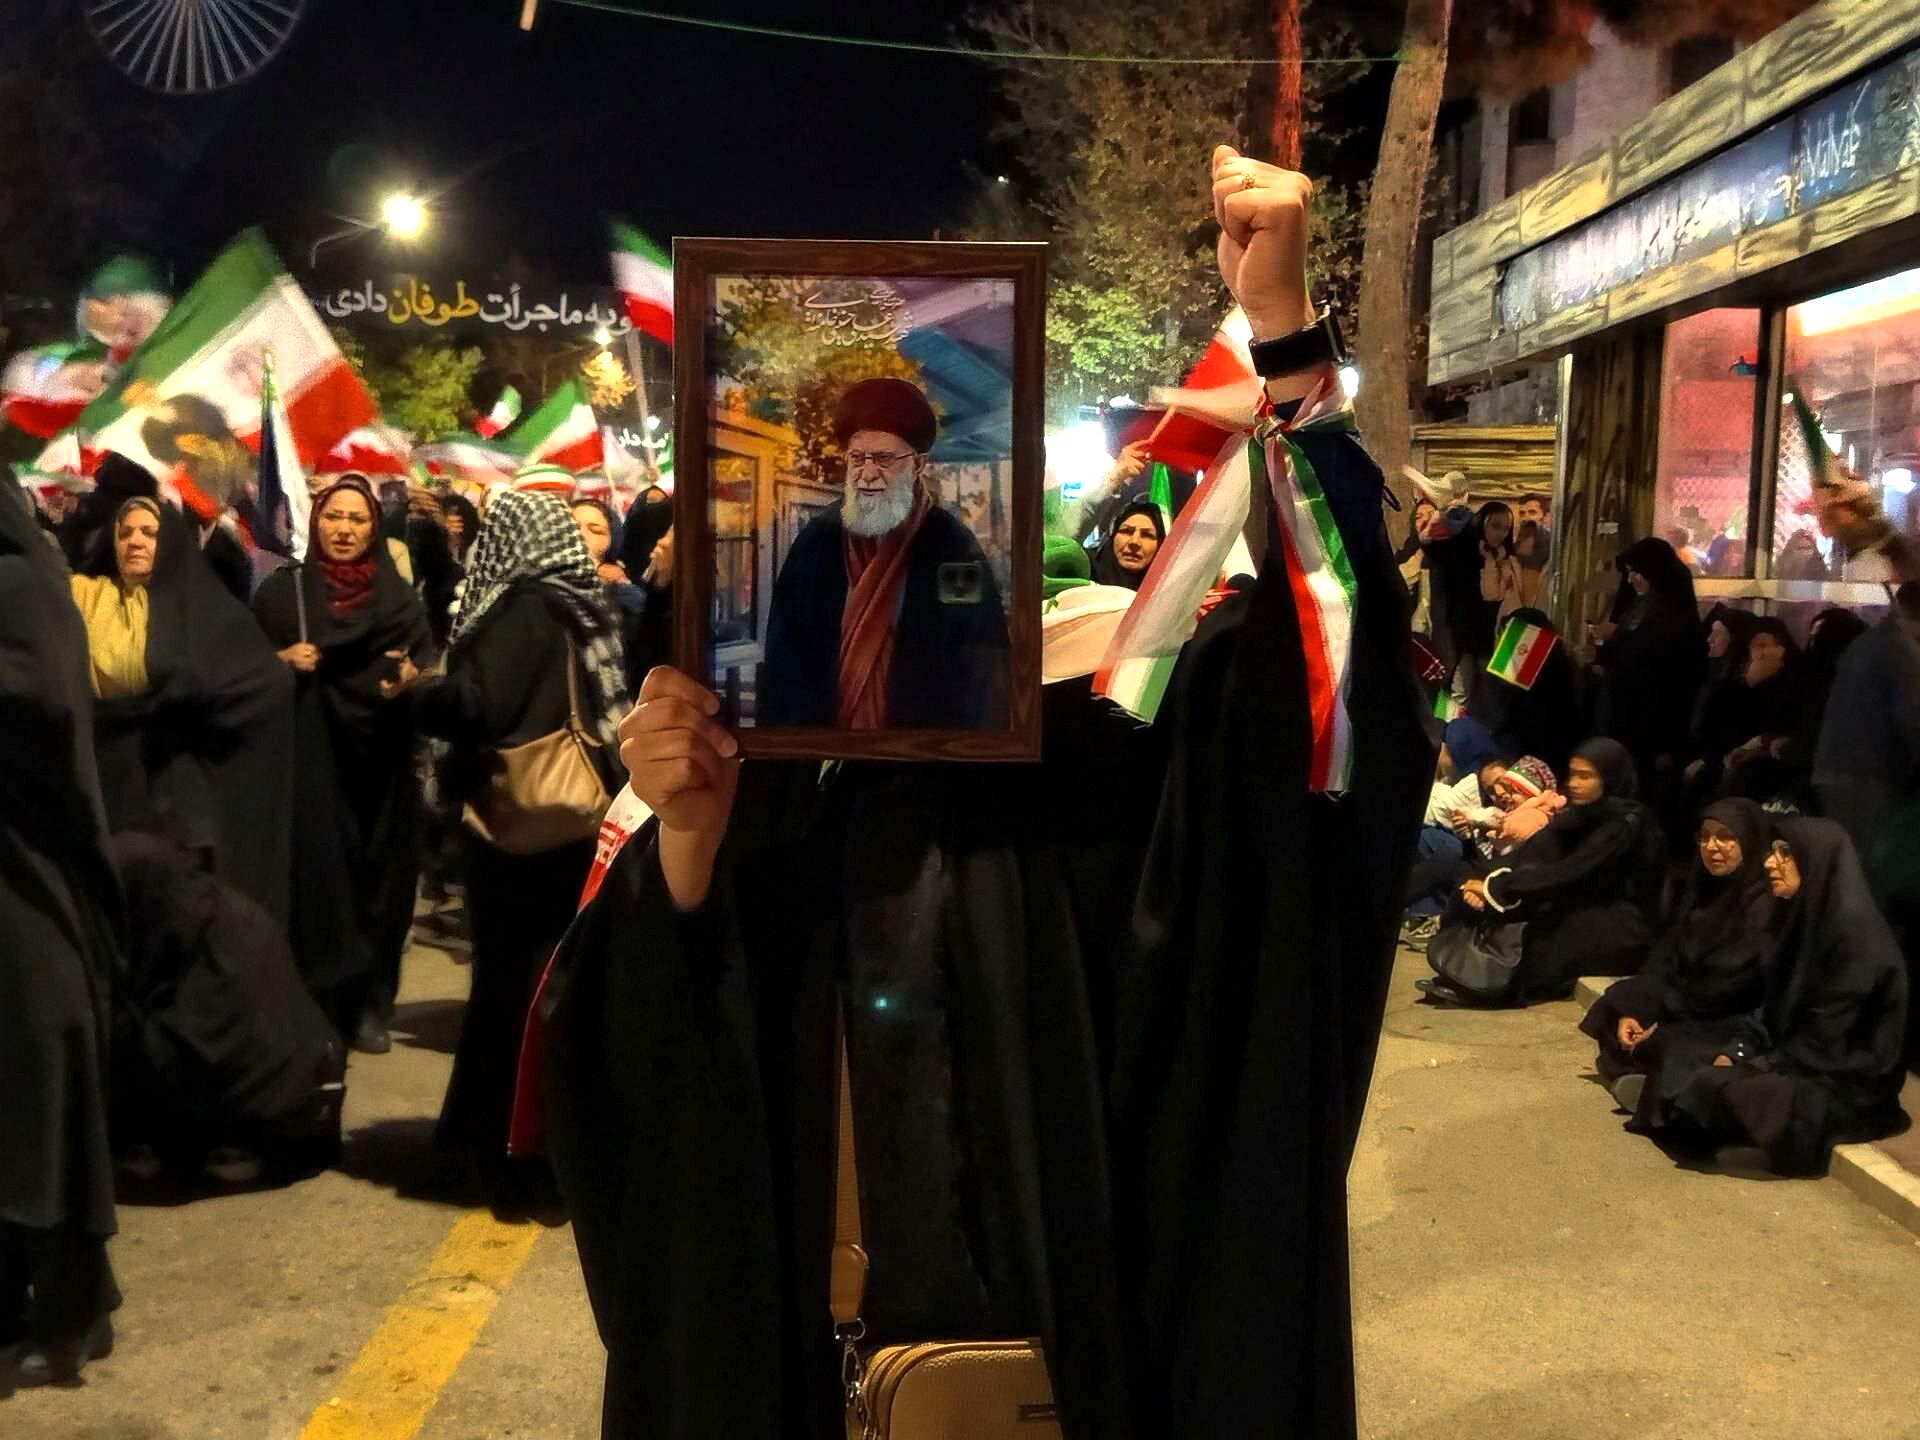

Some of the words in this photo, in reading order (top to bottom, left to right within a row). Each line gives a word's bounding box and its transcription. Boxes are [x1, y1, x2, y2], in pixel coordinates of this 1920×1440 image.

[327, 280, 387, 317] دادی
[388, 277, 479, 326] طوفان
[479, 282, 559, 332] جرأت
[560, 293, 582, 326] ما
